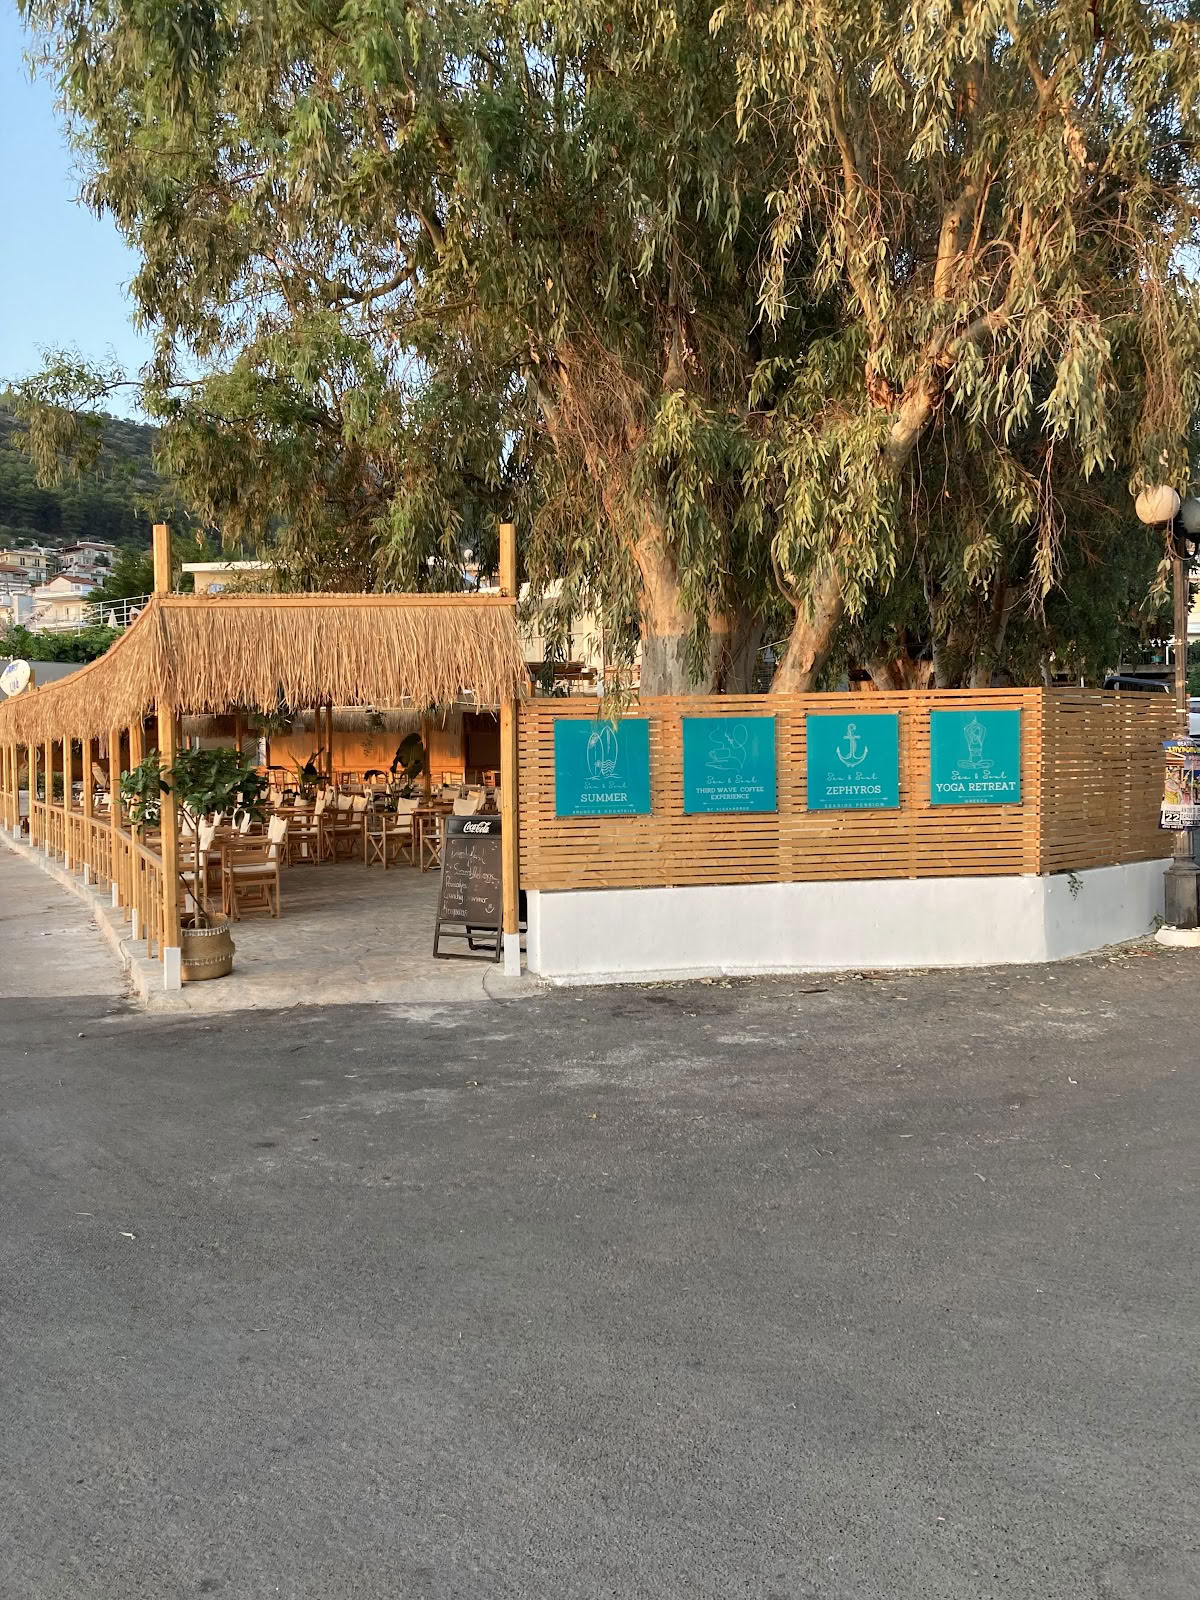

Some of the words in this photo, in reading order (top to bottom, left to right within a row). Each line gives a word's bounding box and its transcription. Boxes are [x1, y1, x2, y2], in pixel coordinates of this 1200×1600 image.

[706, 775, 725, 785] Sea
[734, 774, 758, 784] Soul
[826, 772, 845, 782] Sea
[854, 771, 878, 781] Soul
[951, 770, 971, 781] Sea
[982, 769, 1008, 780] Soul
[825, 785, 882, 796] ZEPHYROS
[935, 782, 966, 793] YOGA
[968, 781, 1017, 792] RETREAT
[580, 792, 628, 803] SUMMER
[710, 793, 750, 801] EXPERIENCE
[1165, 813, 1180, 822] 22
